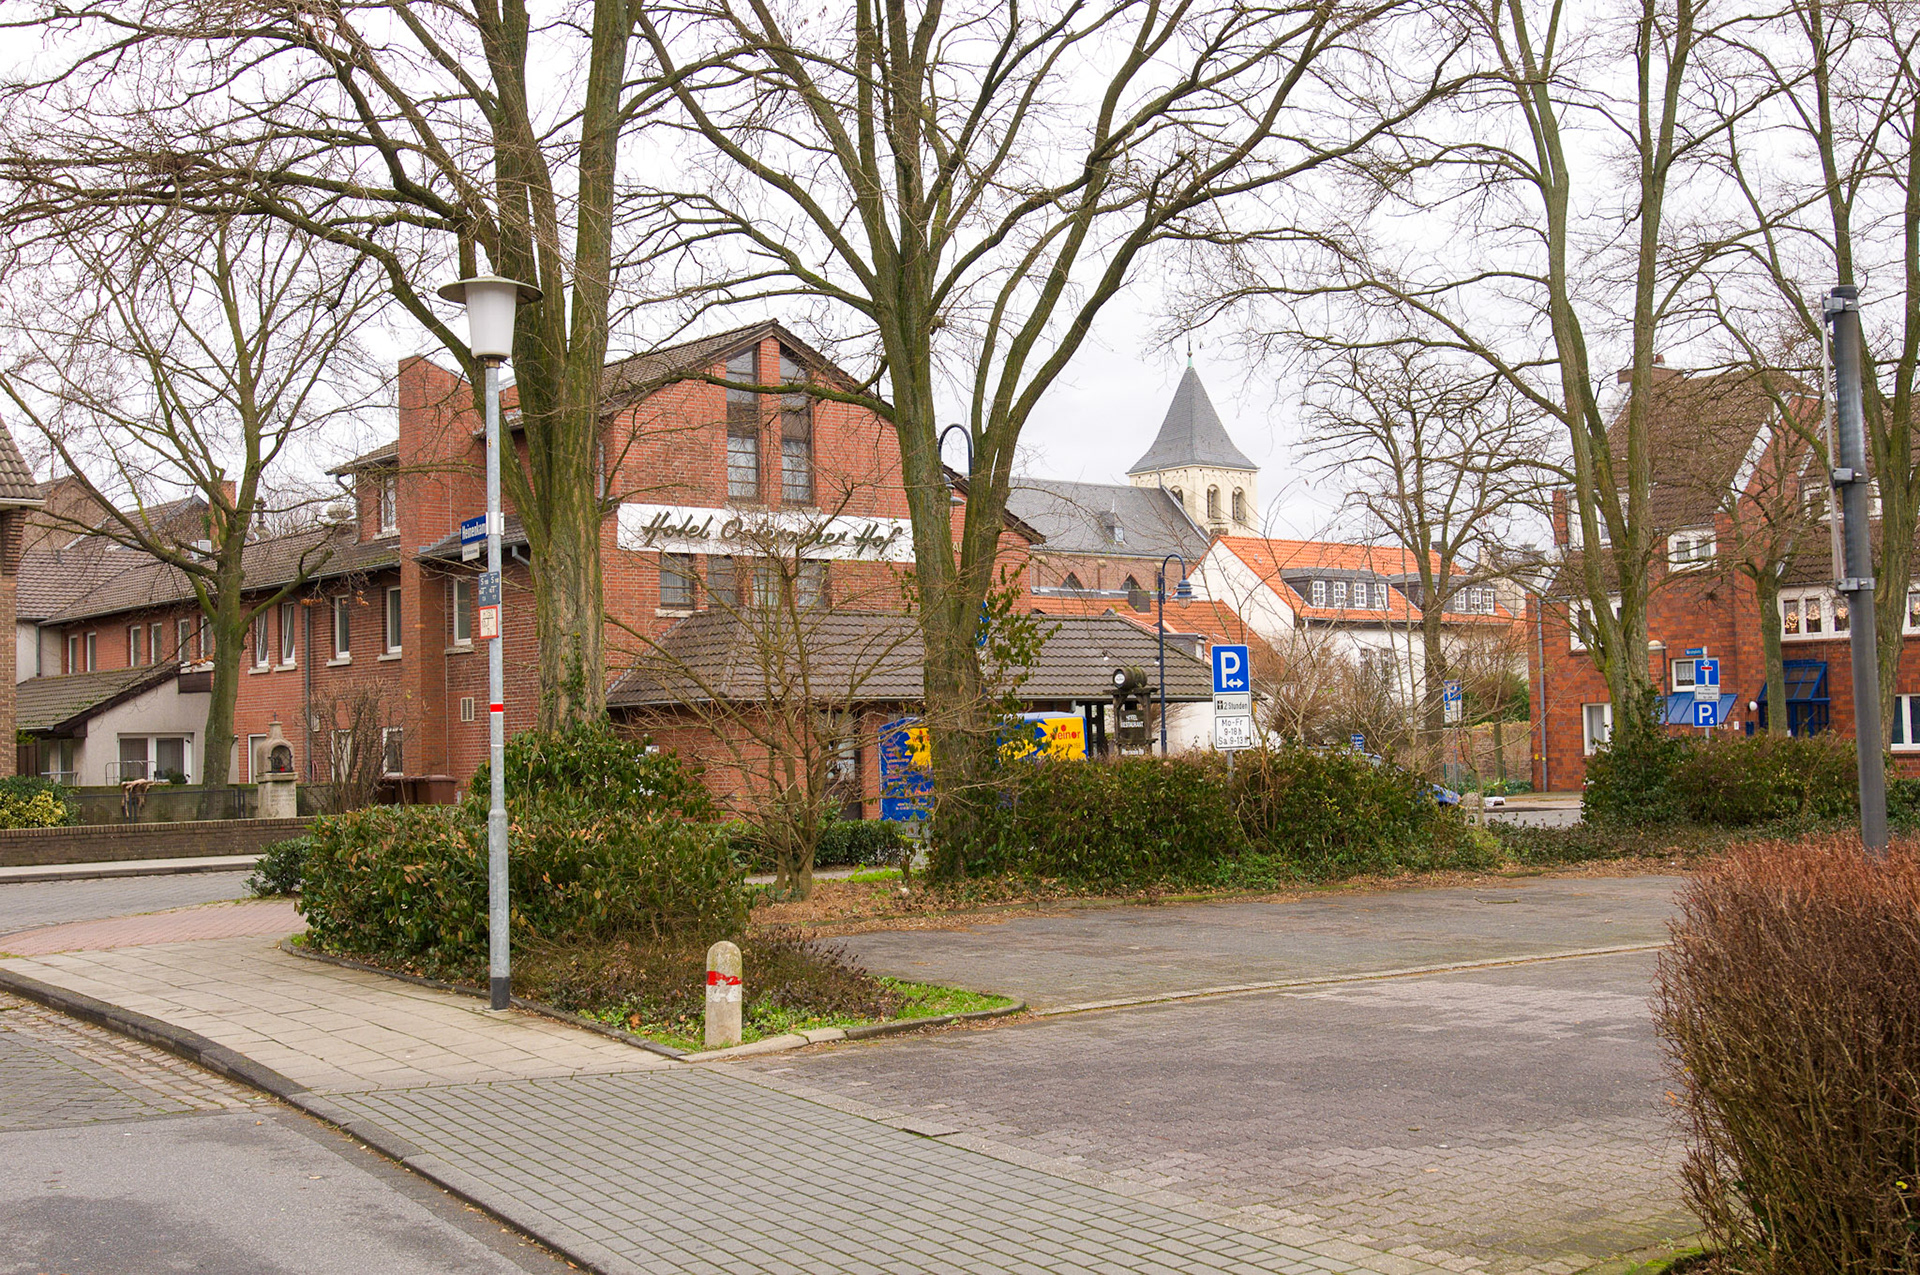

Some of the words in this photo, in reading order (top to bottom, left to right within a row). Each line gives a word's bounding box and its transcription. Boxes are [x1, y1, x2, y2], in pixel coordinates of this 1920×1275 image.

[461, 521, 487, 541] Heinenkam
[641, 510, 713, 547] Hotel
[853, 522, 903, 558] Hof
[1221, 651, 1240, 688] P
[1224, 702, 1228, 710] 2
[1229, 701, 1247, 710] Stunden
[1698, 704, 1713, 724] P
[1221, 718, 1243, 727] Mo-Fr
[1050, 724, 1081, 740] weinor
[1224, 727, 1237, 736] 9-18
[1218, 736, 1228, 745] Sa
[1230, 736, 1243, 744] 9-13
